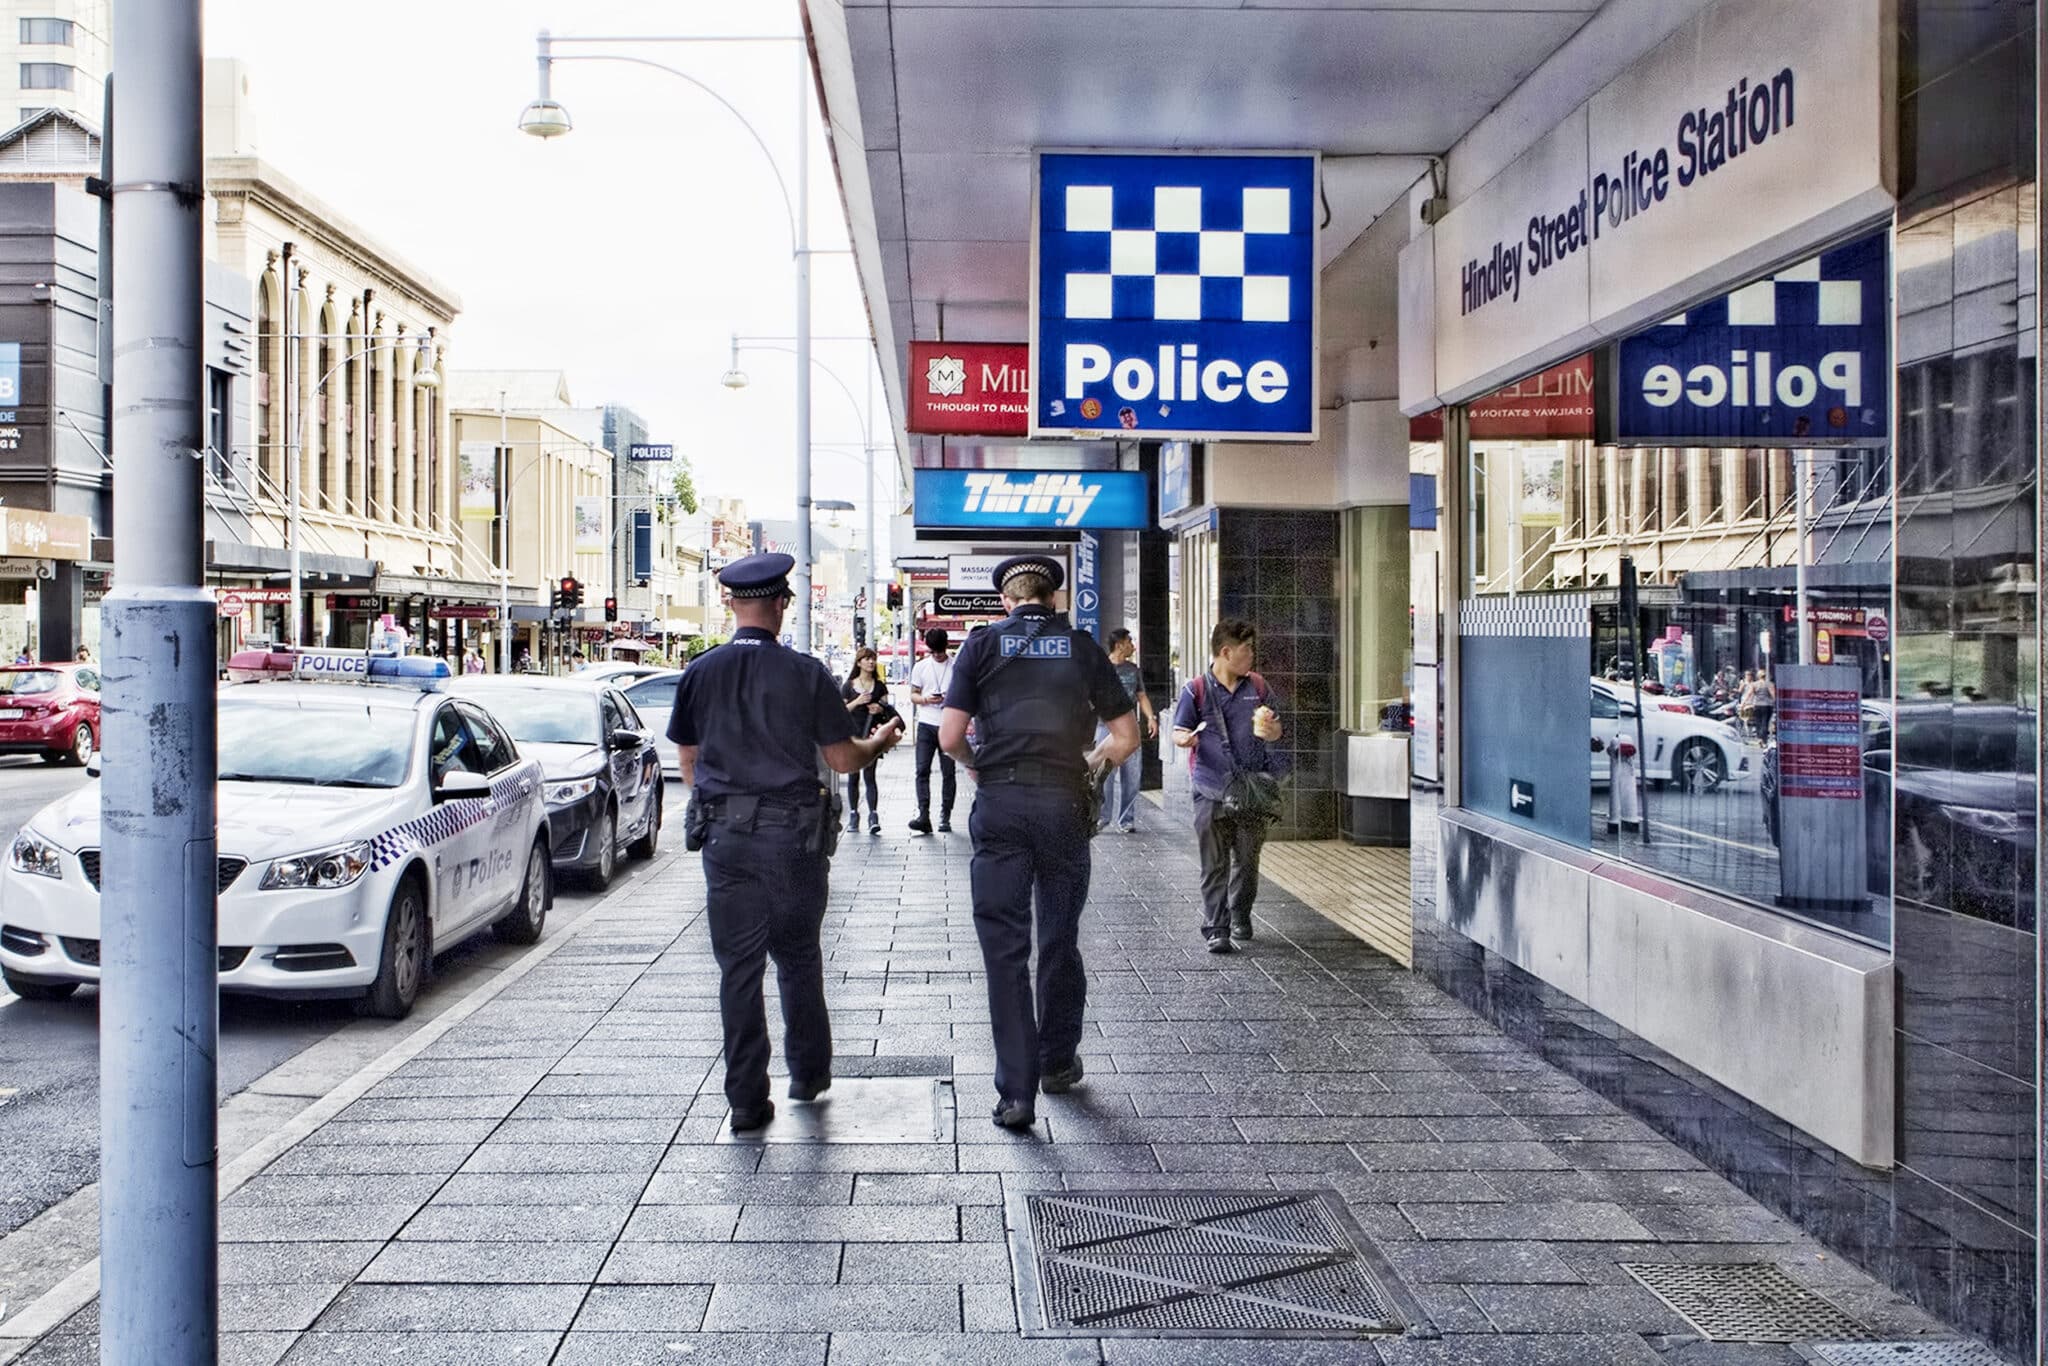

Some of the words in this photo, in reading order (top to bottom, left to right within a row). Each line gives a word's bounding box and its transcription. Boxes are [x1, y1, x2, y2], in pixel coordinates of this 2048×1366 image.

[1461, 241, 1523, 316] Hindley
[1527, 188, 1588, 277] Street
[1593, 147, 1670, 242] Police
[1677, 66, 1795, 187] Station
[938, 369, 954, 381] M
[1065, 343, 1290, 403] Police
[926, 402, 980, 412] THROUGH
[983, 404, 998, 413] TO
[631, 447, 672, 459] POLITES
[962, 472, 1103, 526] Thrifty
[943, 598, 972, 609] Daily
[1004, 638, 1068, 655] POLICE
[301, 656, 365, 672] POLICE
[469, 849, 512, 889] Police
